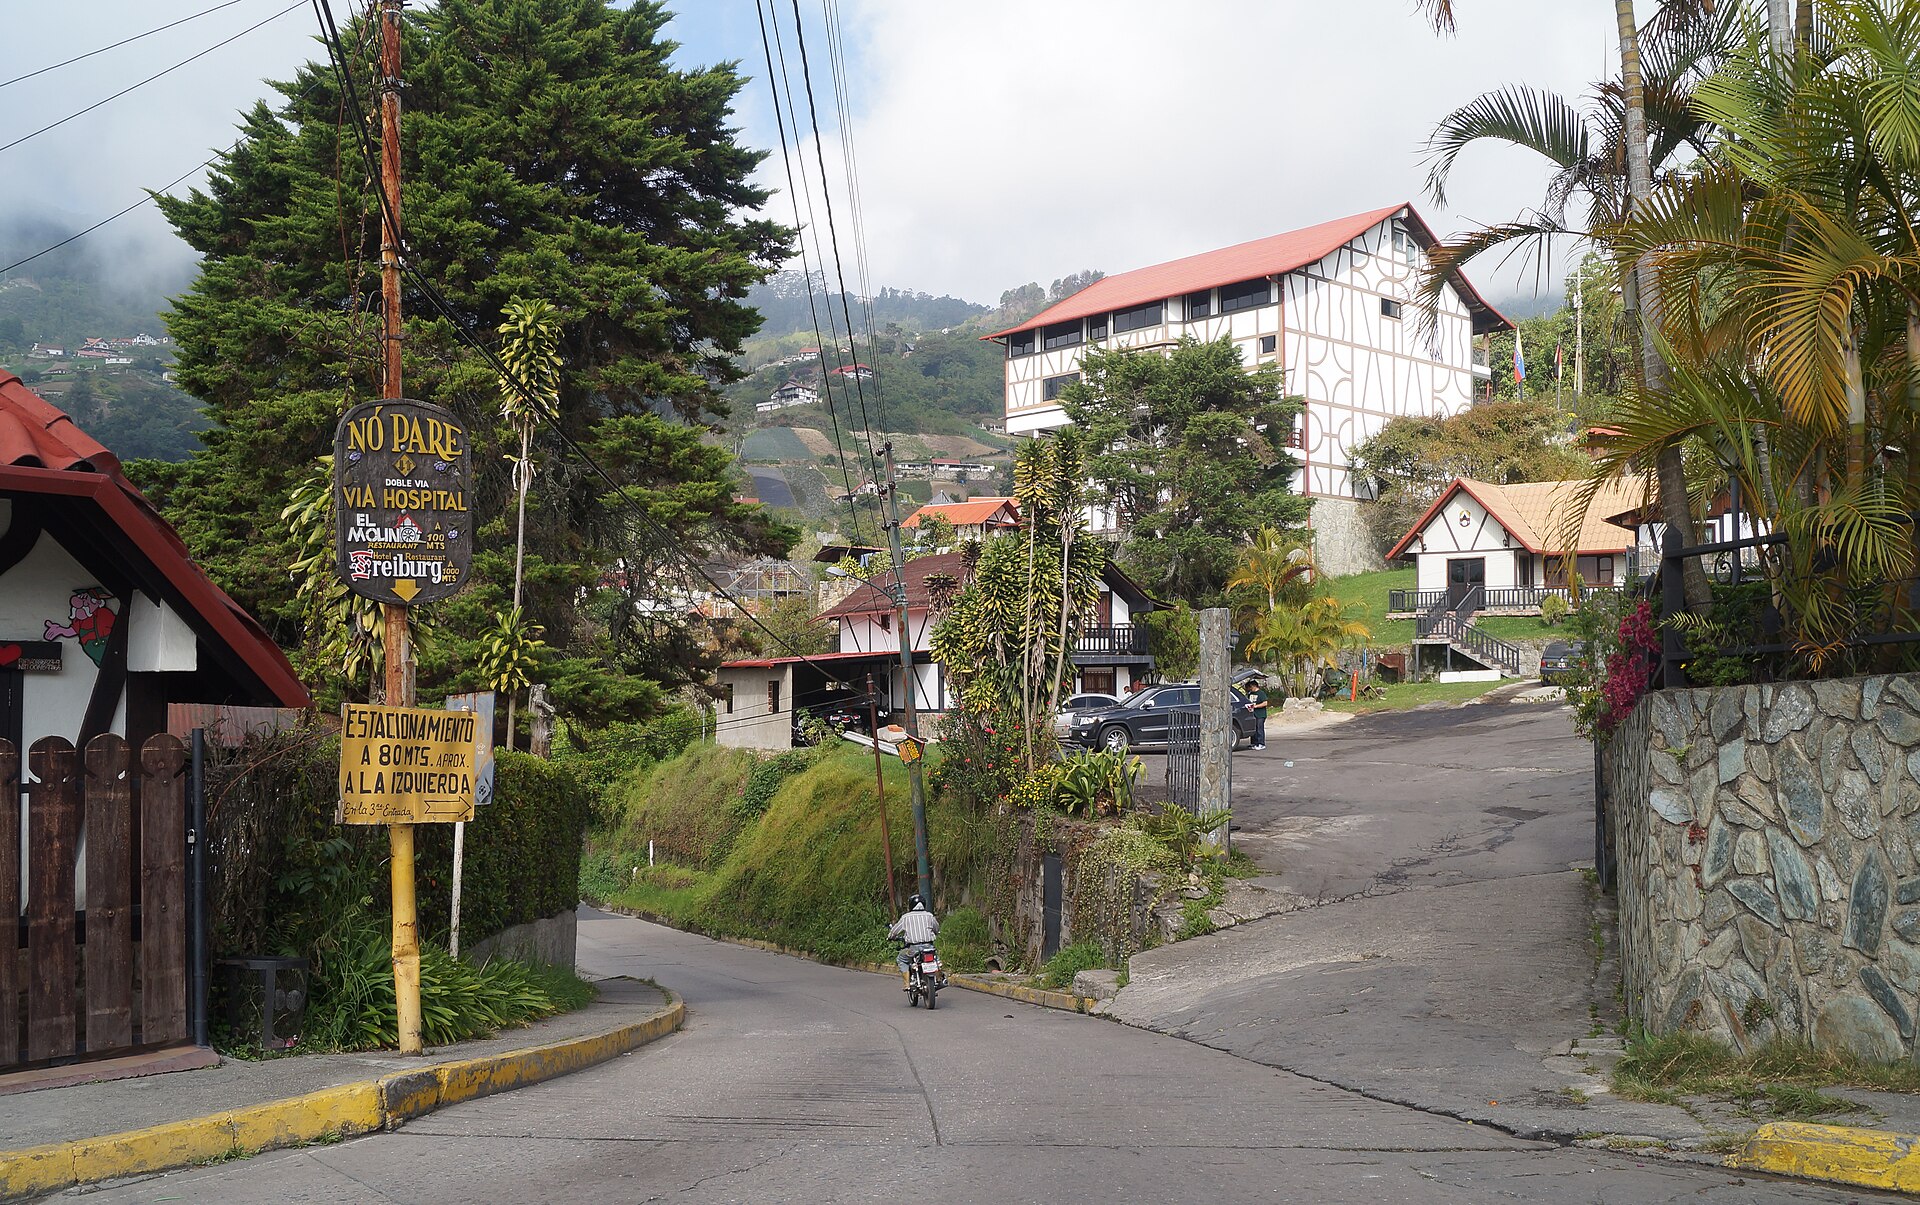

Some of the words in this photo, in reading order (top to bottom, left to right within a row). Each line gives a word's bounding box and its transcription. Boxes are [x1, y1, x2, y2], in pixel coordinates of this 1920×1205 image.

[389, 413, 463, 462] PARE
[385, 478, 412, 488] DOBLE
[414, 479, 430, 489] VIA
[342, 483, 377, 509] VIA
[383, 488, 468, 512] HOSPITAL
[356, 513, 377, 528] EL
[434, 521, 442, 531] A
[426, 533, 446, 542] 100
[367, 541, 419, 550] RESTAURANT
[426, 541, 446, 550] MTS
[373, 551, 393, 561] Hotel
[405, 552, 447, 561] Restaurant
[447, 560, 454, 568] A
[441, 574, 457, 583] MTS
[345, 709, 475, 743] ESTACIONAMIENTO
[360, 744, 371, 766] A
[435, 753, 470, 768] APROX.
[344, 770, 354, 794] A
[391, 771, 471, 795] IZQUIERDA
[383, 803, 411, 817] Entrada
